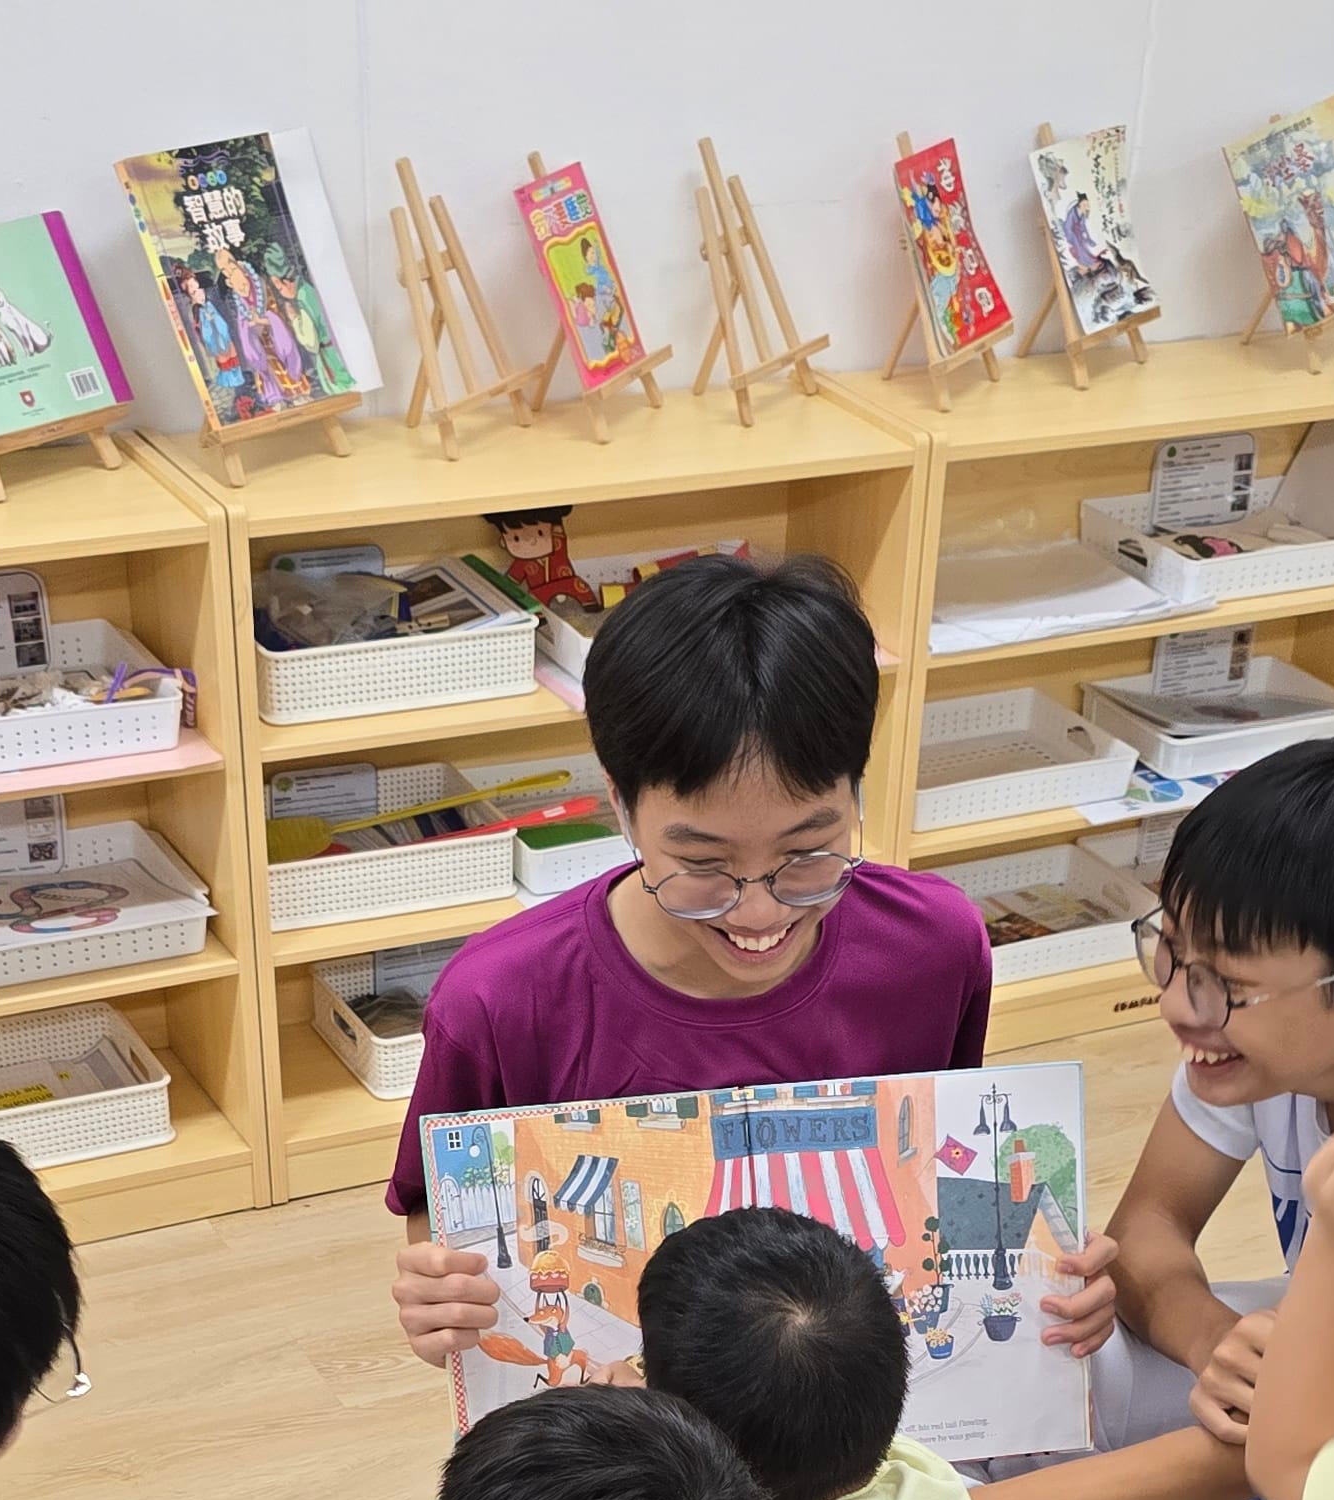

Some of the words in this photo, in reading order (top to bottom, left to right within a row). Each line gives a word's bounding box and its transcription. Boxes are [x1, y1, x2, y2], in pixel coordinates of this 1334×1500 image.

[183, 186, 246, 224] 智慧的
[720, 1113, 870, 1149] FLOWERS
